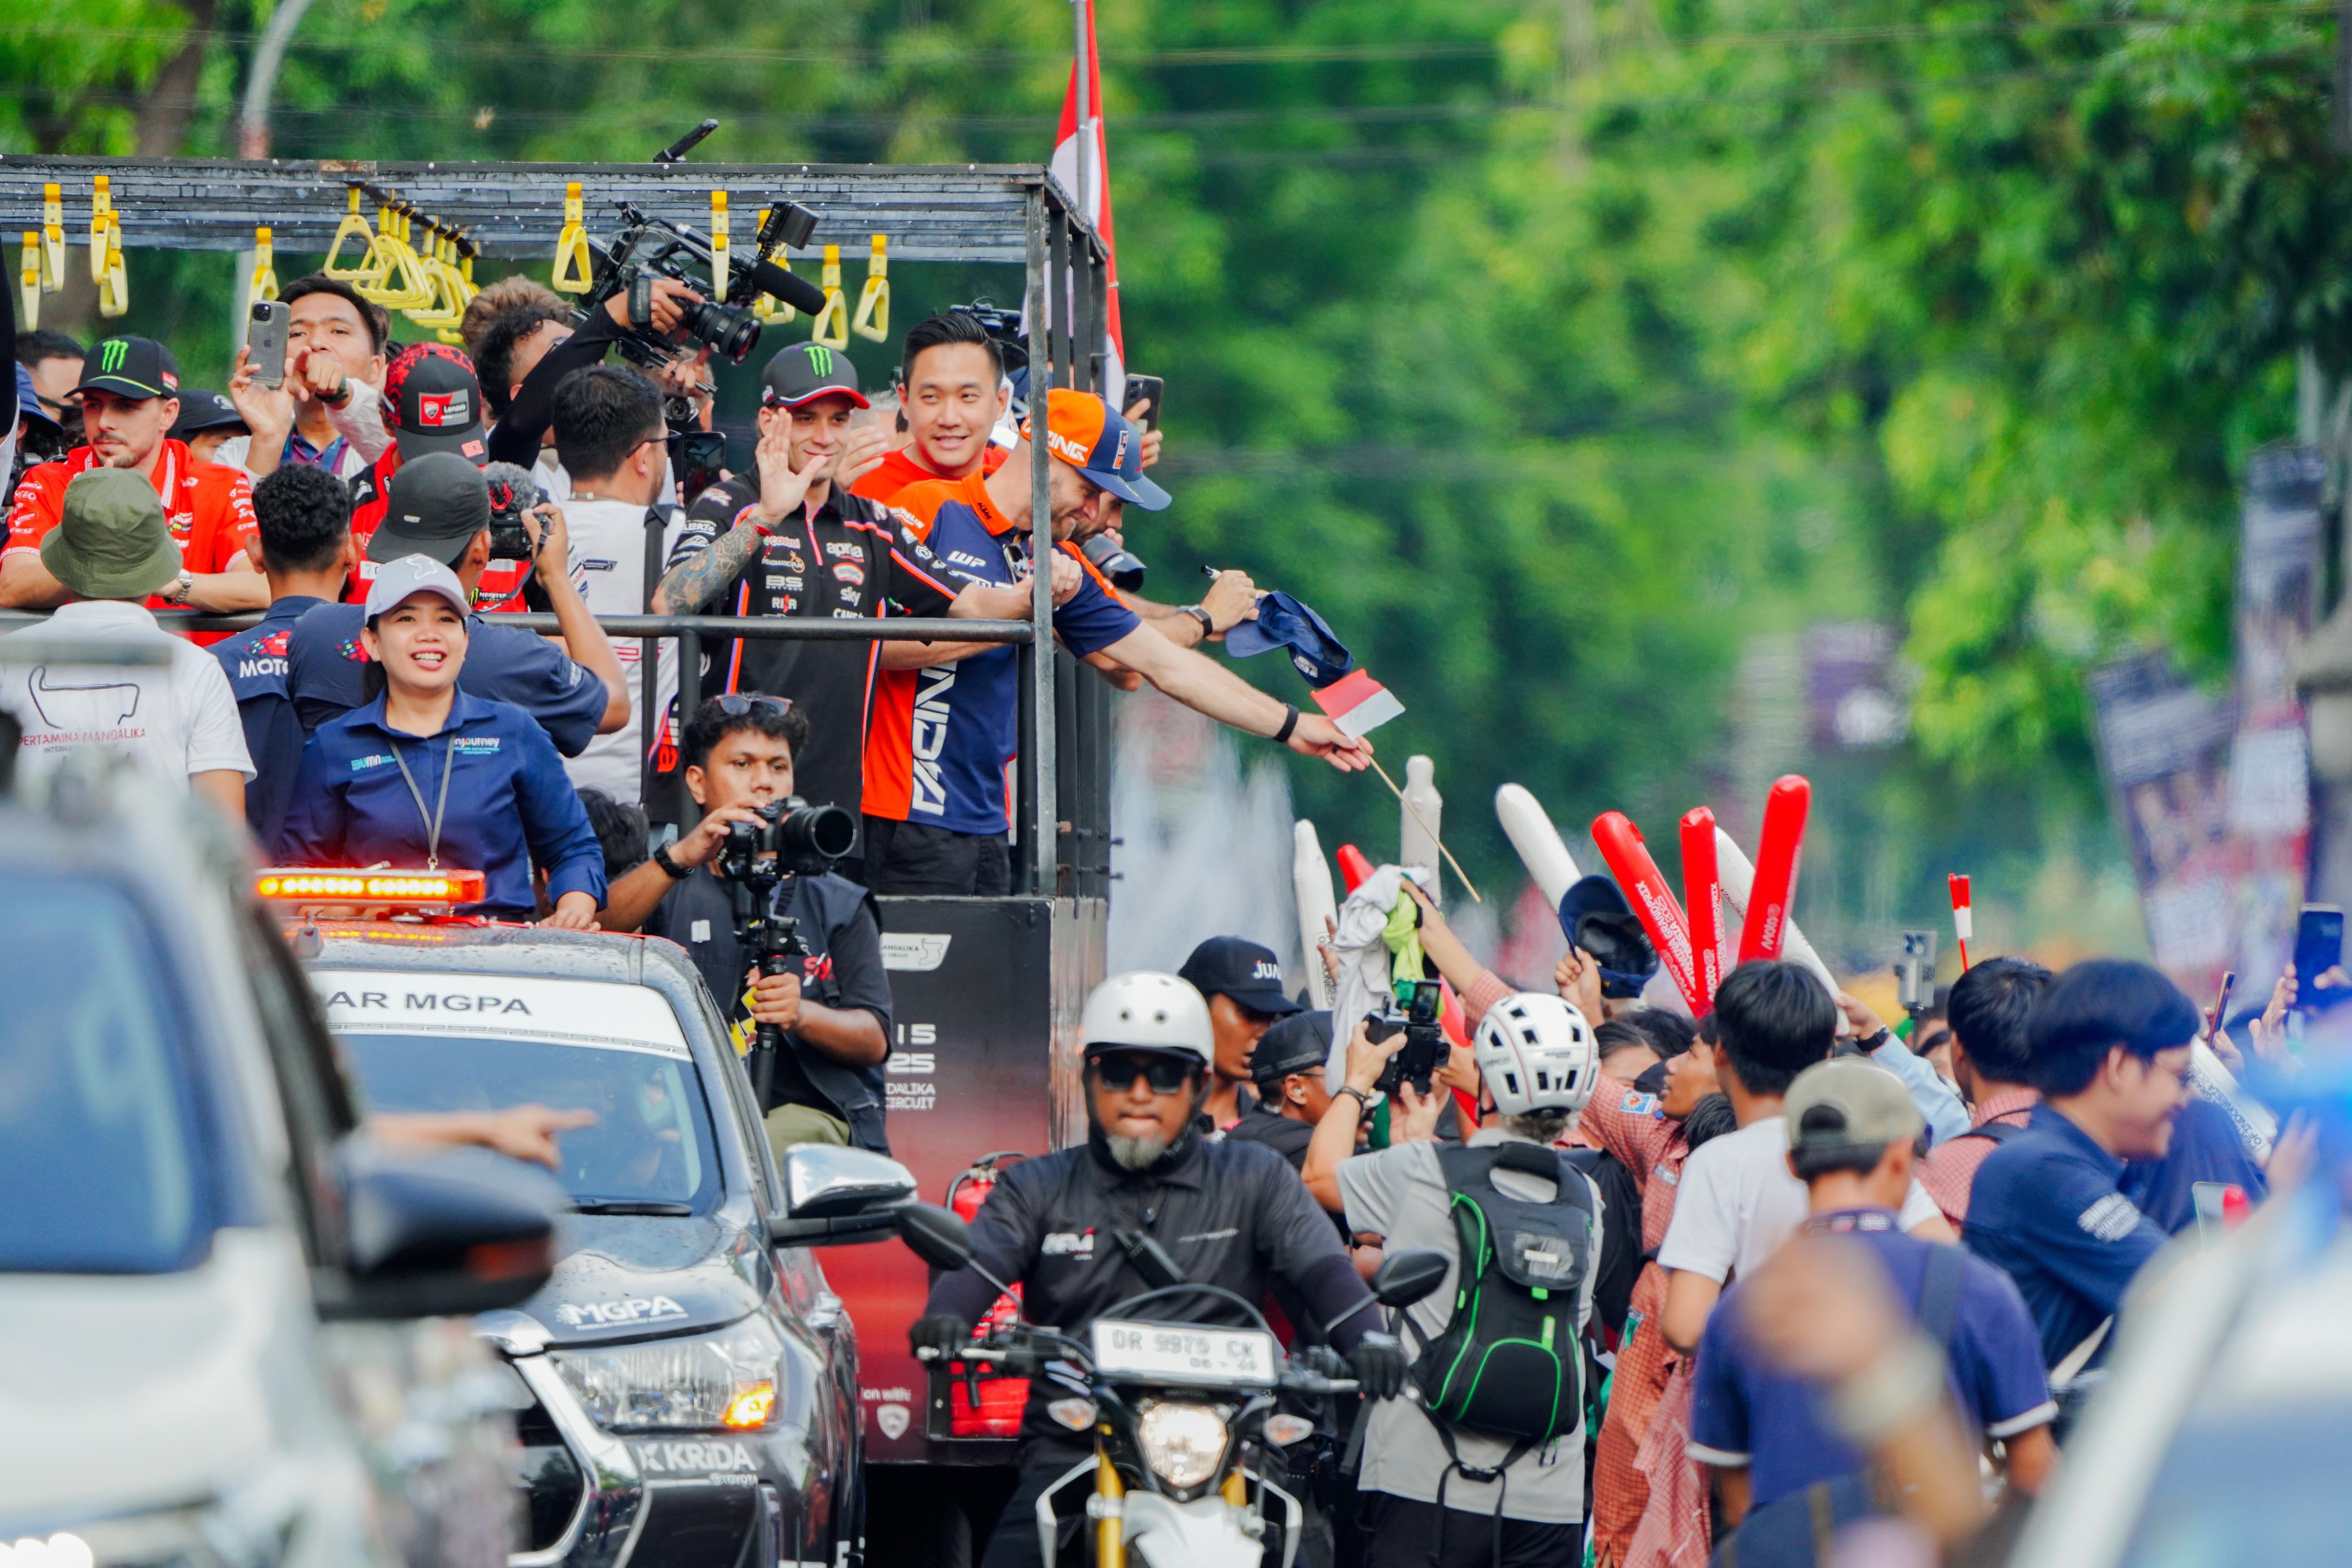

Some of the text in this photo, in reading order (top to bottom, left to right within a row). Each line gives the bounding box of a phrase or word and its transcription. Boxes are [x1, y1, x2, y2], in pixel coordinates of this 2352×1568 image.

[444, 404, 466, 414] Lenovo
[769, 536, 801, 549] Castrol
[761, 558, 791, 567] PRAGMATIC
[947, 551, 986, 568] WP
[766, 575, 803, 588] BS
[841, 586, 861, 607] sky
[83, 727, 146, 743] MANDALIKA
[912, 660, 957, 816] RACIN
[1657, 895, 1674, 922] 2025
[1761, 903, 1782, 950] MotoGP
[1704, 948, 1718, 1000] MotoGP
[406, 993, 532, 1016] MGPA
[2208, 1083, 2252, 1132] INDONESIA
[2249, 1133, 2262, 1145] OF
[557, 1294, 686, 1325] MGPA
[1112, 1328, 1143, 1352] DR
[723, 1474, 759, 1487] TOYOTA
